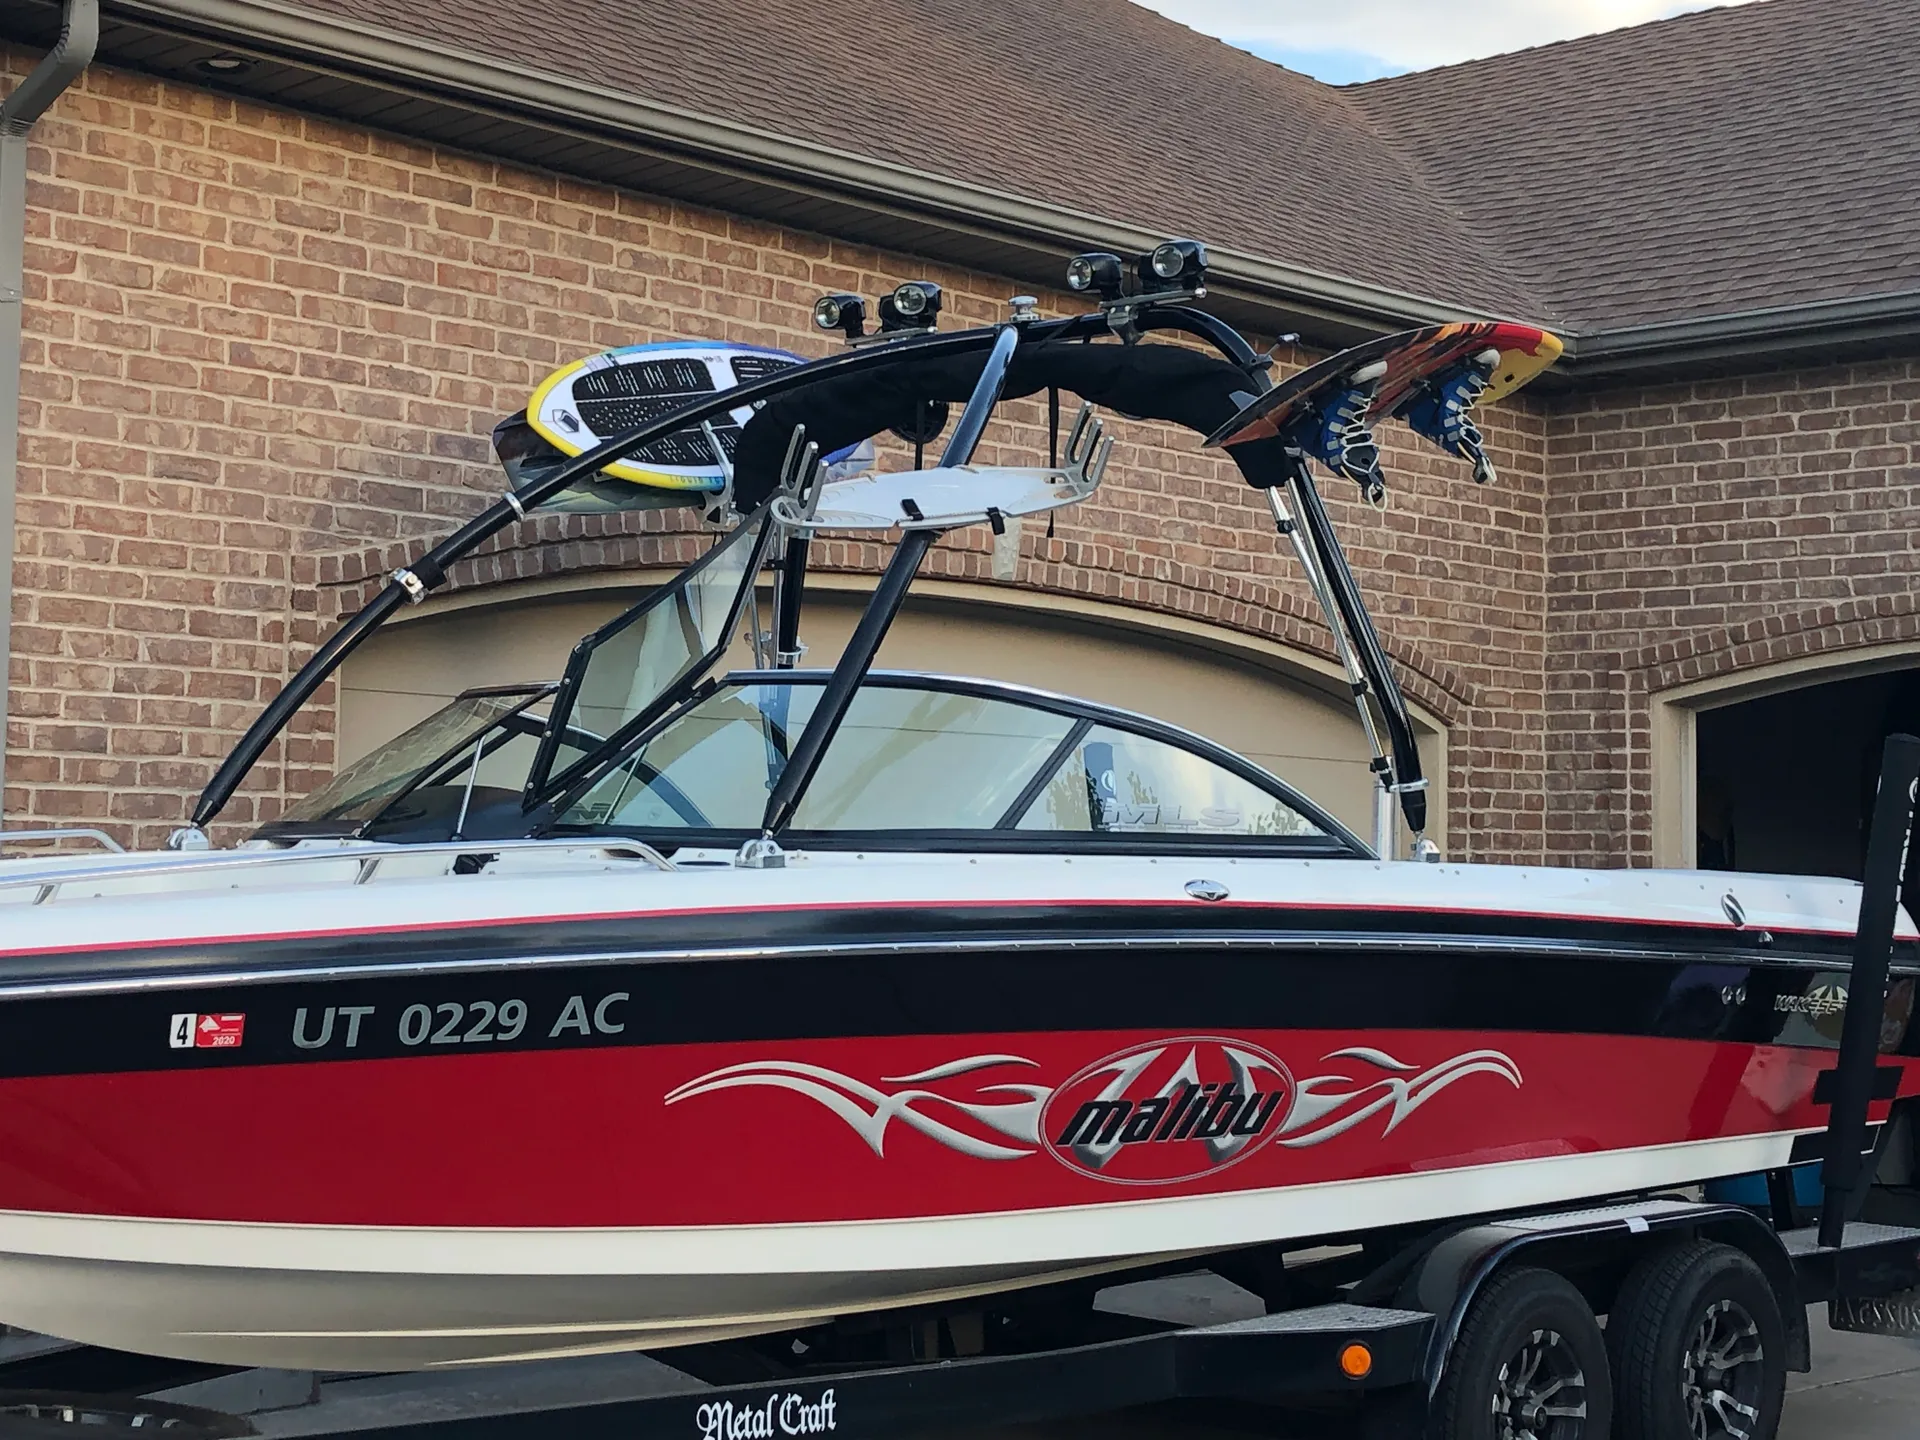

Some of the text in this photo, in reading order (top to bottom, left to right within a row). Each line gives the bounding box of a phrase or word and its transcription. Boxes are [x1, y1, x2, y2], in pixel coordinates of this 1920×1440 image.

[176, 1016, 189, 1046] 4
[212, 1036, 236, 1046] 2020
[292, 992, 631, 1048] UT 0229 AC
[1056, 1083, 1284, 1146] malibu
[696, 1387, 837, 1440] Metal Craft
